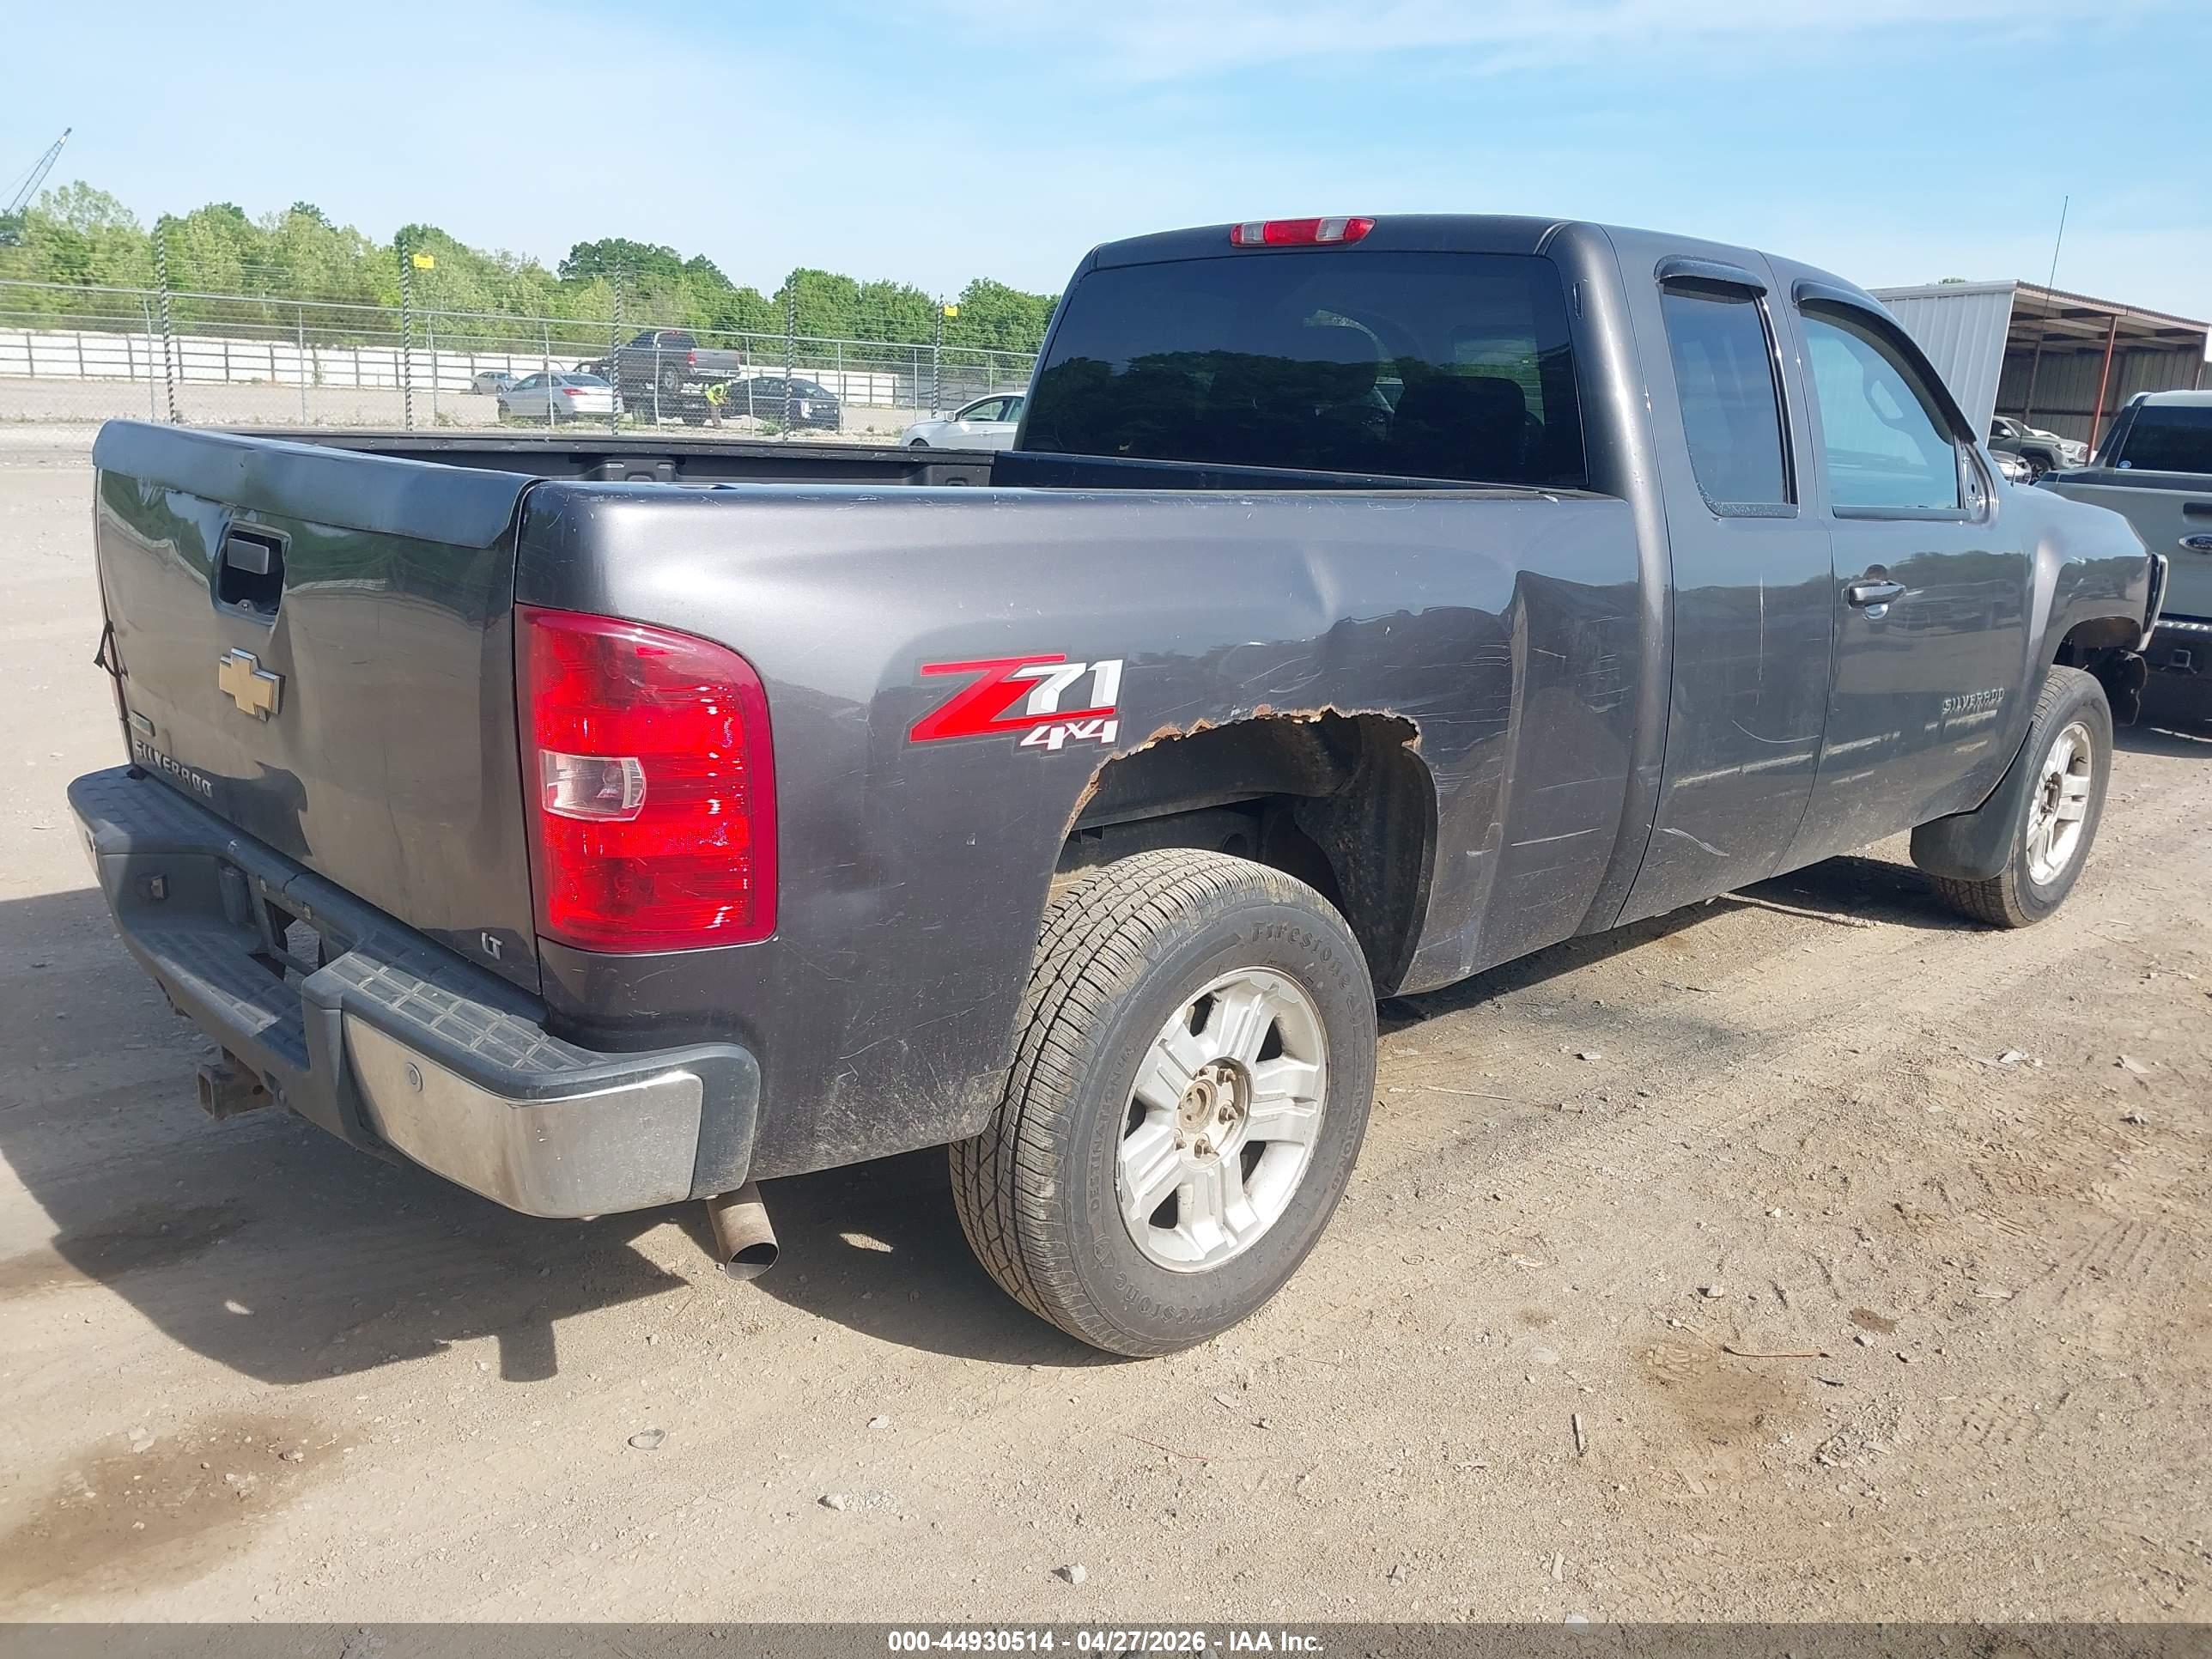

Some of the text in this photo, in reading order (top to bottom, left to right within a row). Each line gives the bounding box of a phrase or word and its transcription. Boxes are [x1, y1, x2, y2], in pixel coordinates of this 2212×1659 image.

[909, 653, 1123, 743] Z71
[1942, 688, 2005, 712] SILVERADO
[135, 740, 213, 798] SILVERADO
[481, 932, 503, 960] LT
[1252, 921, 1351, 989] Firestone
